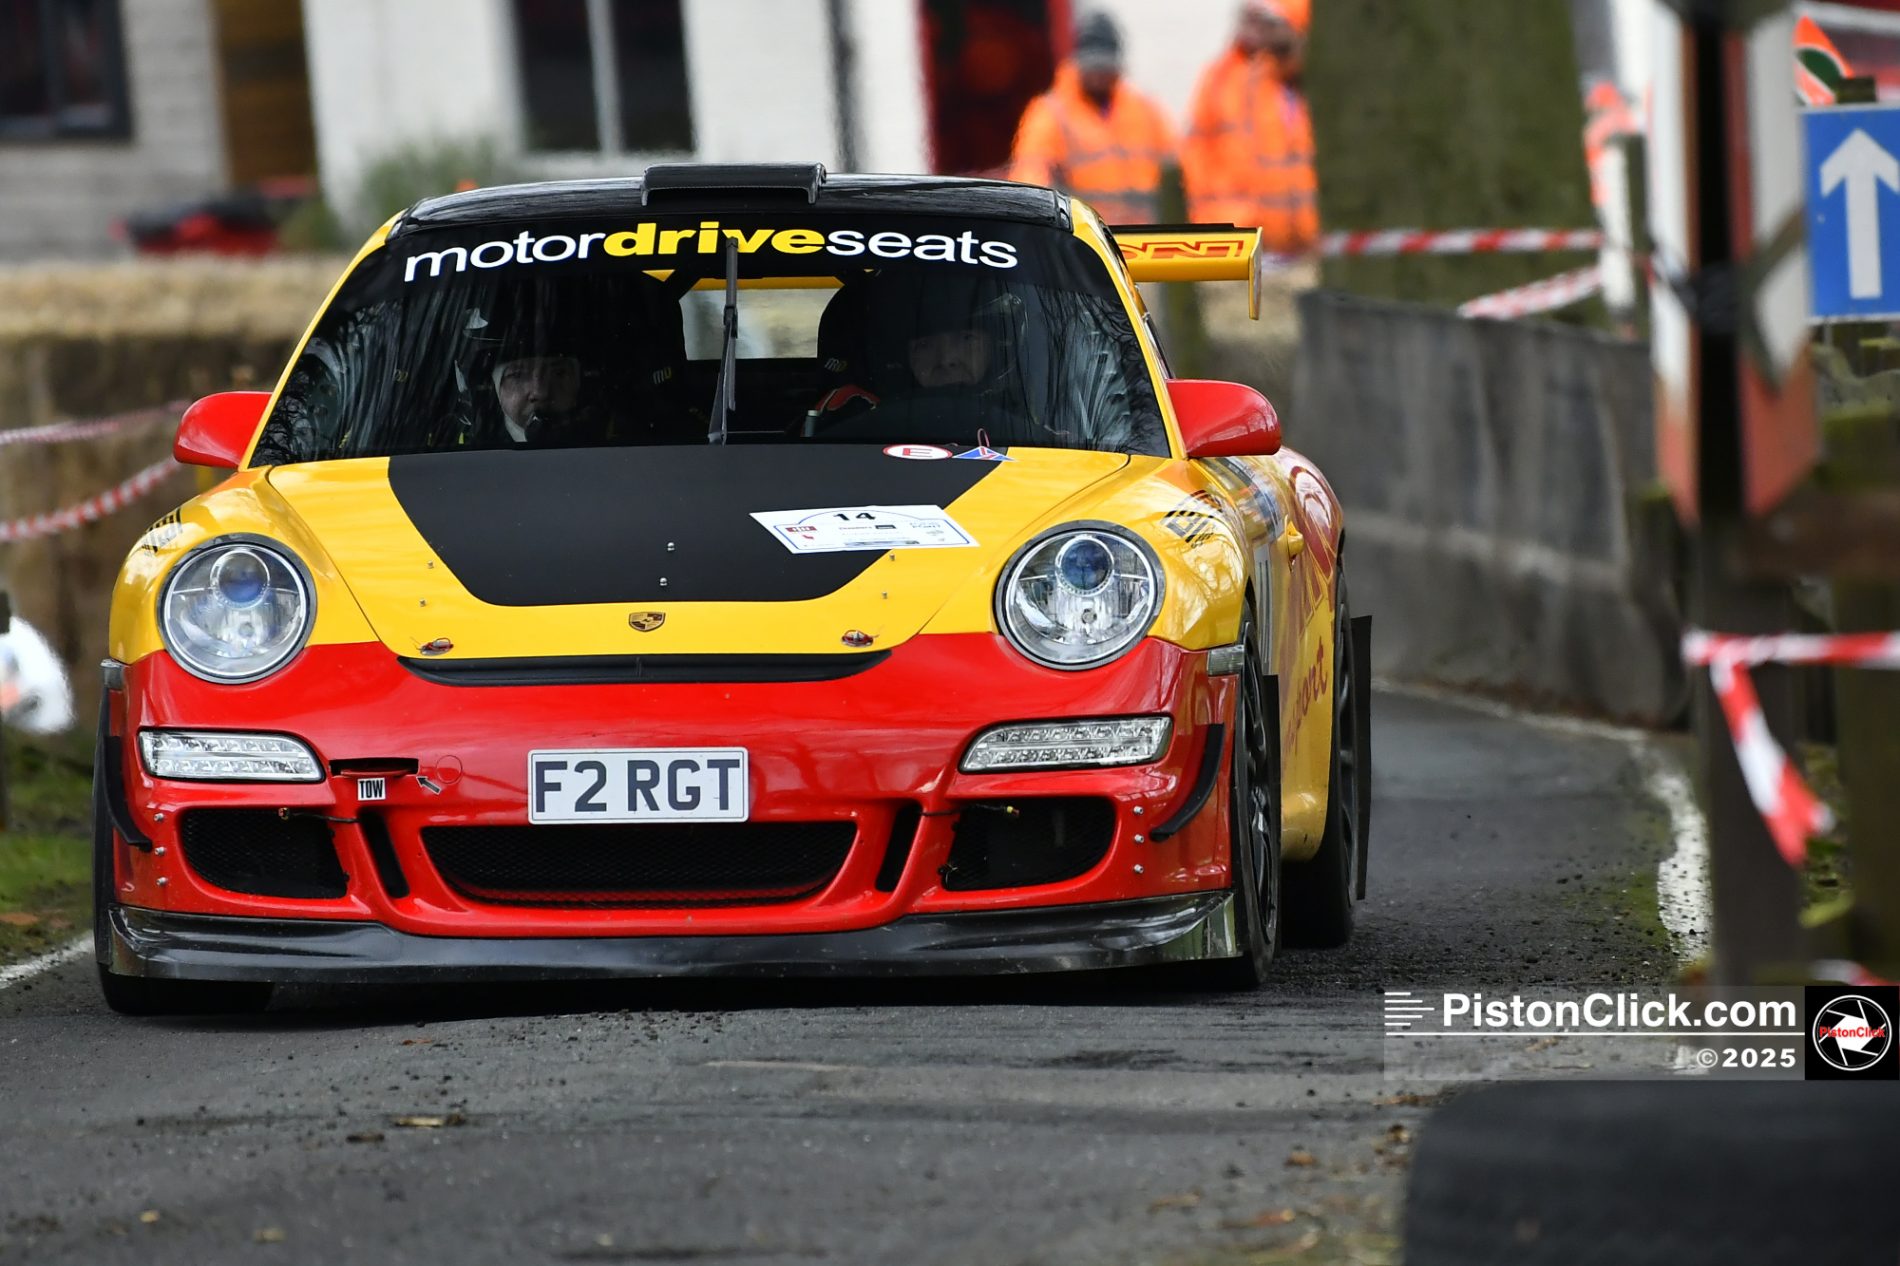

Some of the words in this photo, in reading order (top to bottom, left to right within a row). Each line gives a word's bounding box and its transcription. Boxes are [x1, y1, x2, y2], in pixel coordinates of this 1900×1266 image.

[404, 221, 1018, 282] motordriveseats
[902, 447, 933, 458] E
[833, 511, 876, 521] 14
[358, 780, 384, 799] TOW
[535, 760, 607, 813] F2
[627, 758, 740, 811] RGT
